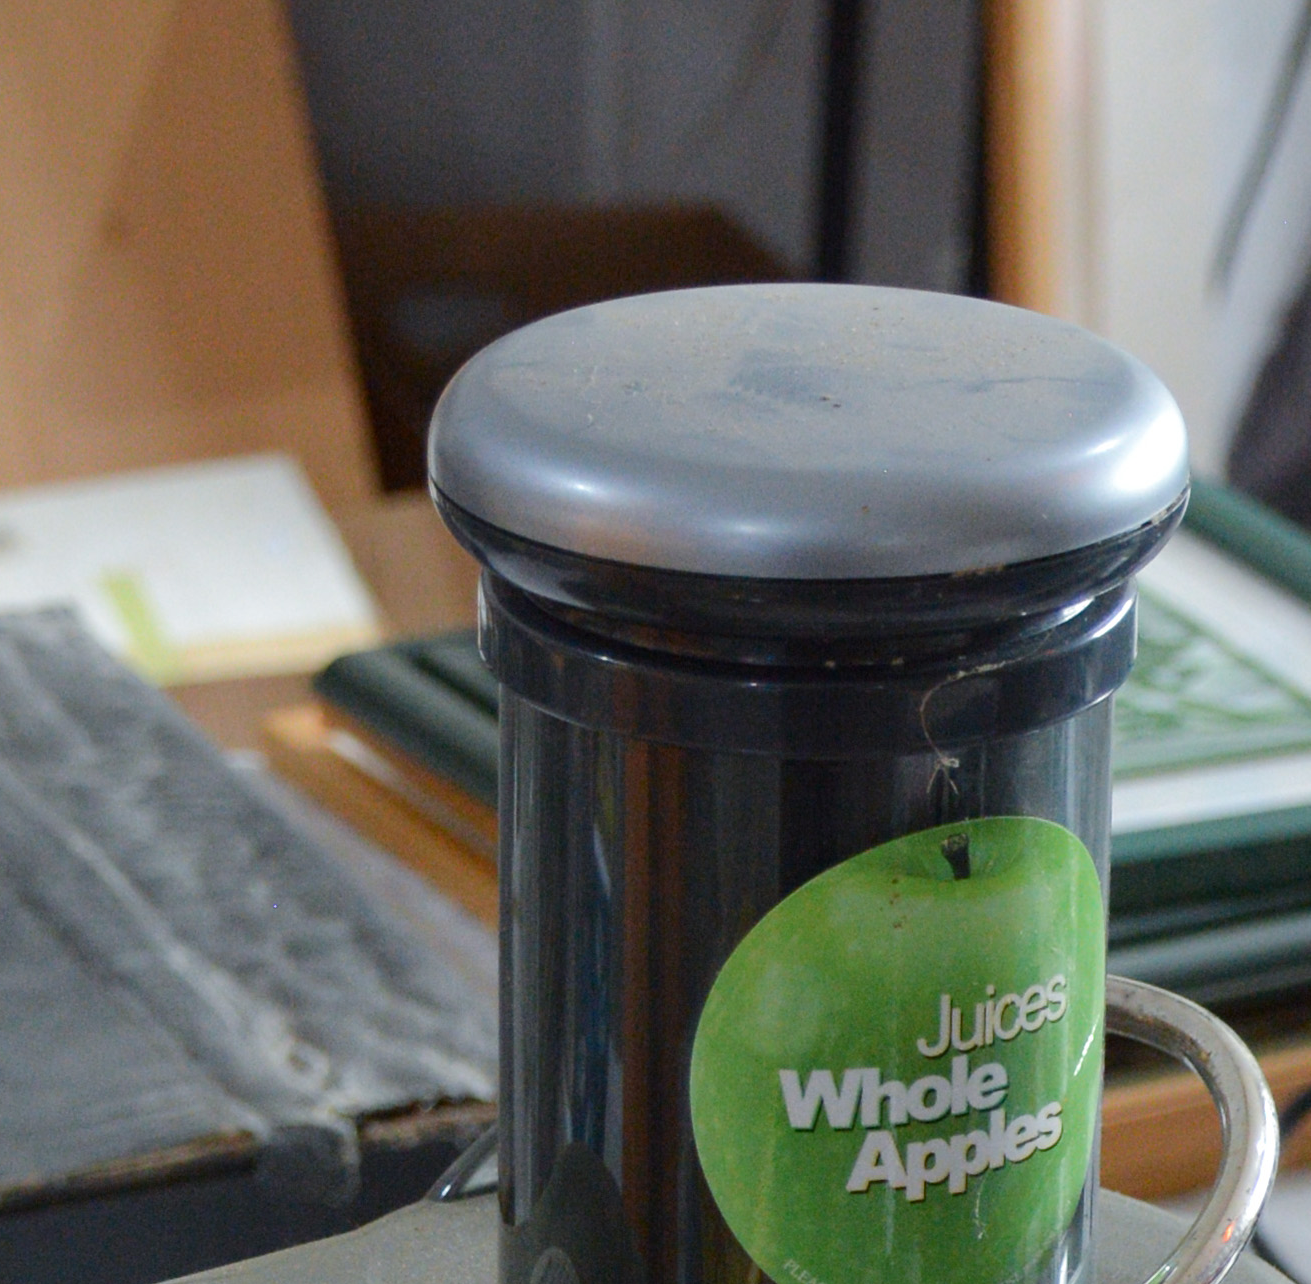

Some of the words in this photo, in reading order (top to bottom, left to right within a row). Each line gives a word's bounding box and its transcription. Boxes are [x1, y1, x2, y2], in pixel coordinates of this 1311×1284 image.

[917, 974, 1068, 1057] Juices
[779, 1055, 1009, 1131] Whole
[845, 1101, 1063, 1202] Apples
